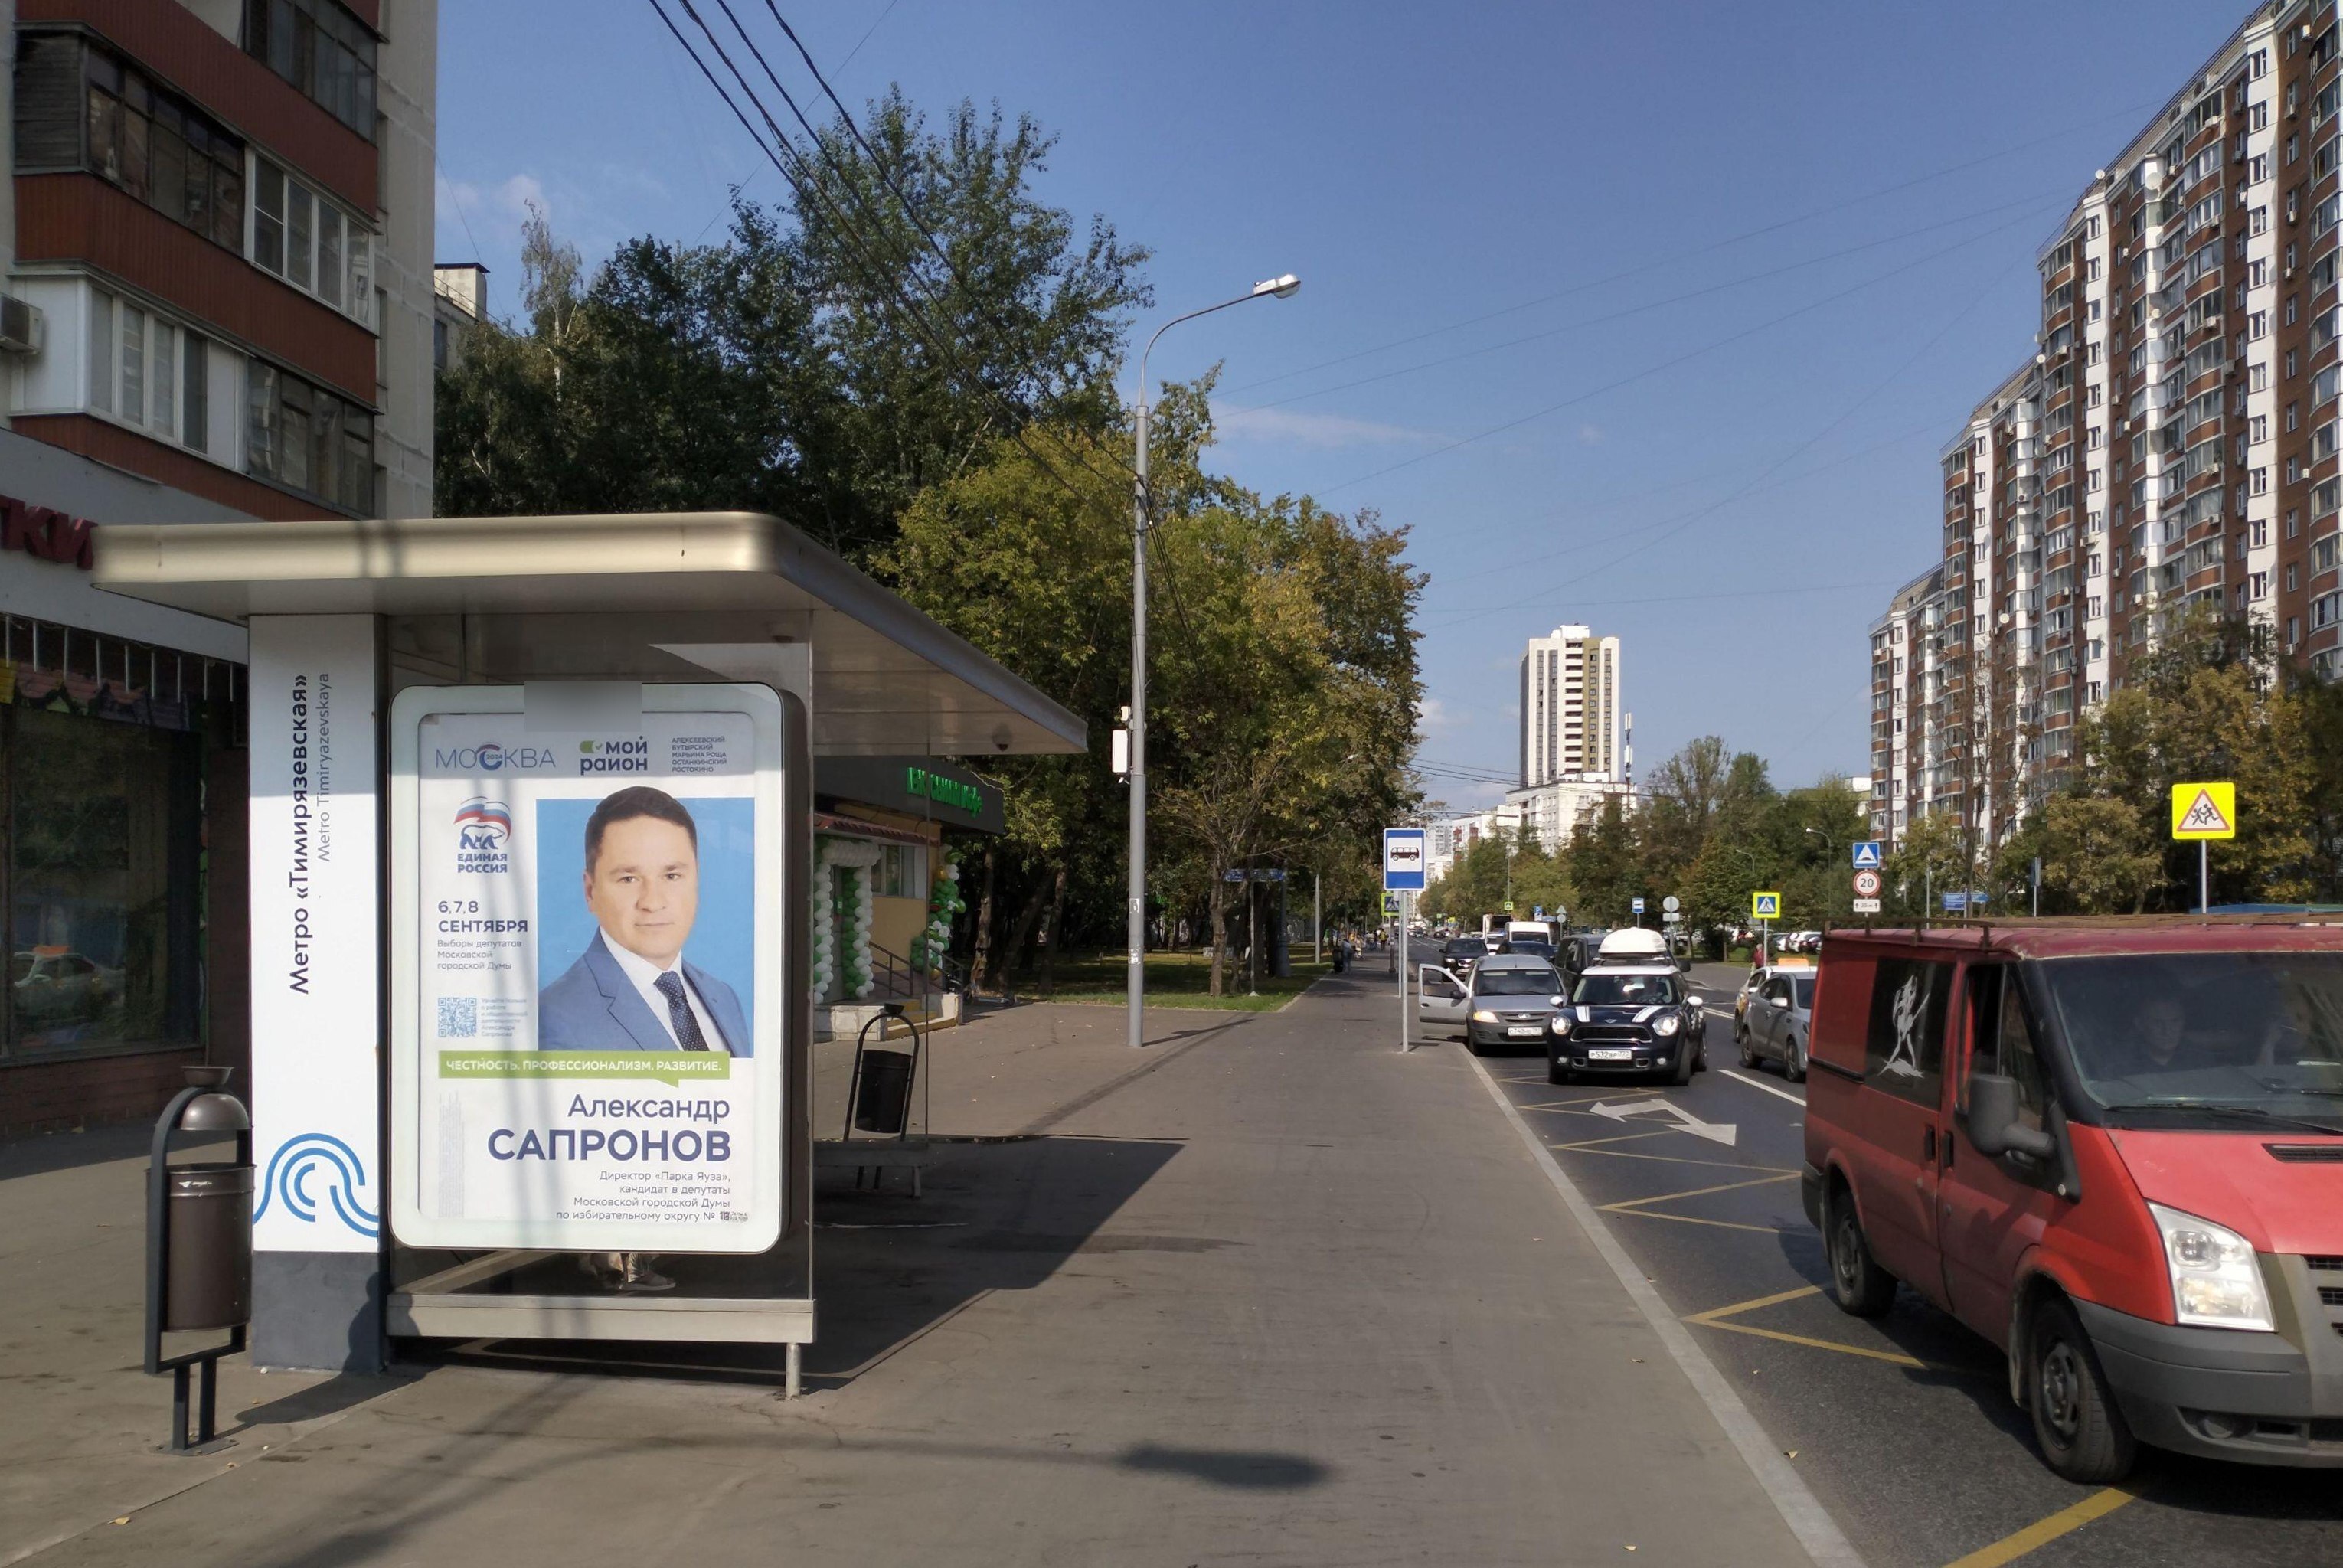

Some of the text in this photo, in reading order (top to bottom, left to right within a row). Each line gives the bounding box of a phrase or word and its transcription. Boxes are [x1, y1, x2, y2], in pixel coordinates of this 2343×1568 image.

[606, 735, 648, 754] мой
[672, 735, 726, 743] АЛЕКСЕЕВСКИЙ
[436, 743, 557, 771] МОСКВА
[316, 672, 332, 862] Metro Timiryazevskaya
[289, 674, 313, 994] Метро «Тимирязевская»
[458, 853, 508, 862] ЕДИНАЯ
[458, 864, 508, 873] РОССИЯ
[1860, 878, 1874, 888] 20
[438, 920, 528, 933] СЕНТЯБРЯ
[437, 939, 522, 949] Выборы депутатов
[437, 950, 493, 959] Московской
[487, 962, 512, 971] Думы
[446, 1060, 722, 1071] ЧЕСТНОСТЬ. ПРОФЕССИОНАЛИЗМ. РАЗВИТИЕ.
[567, 1093, 730, 1124] Александр
[487, 1128, 731, 1161] САПРОНОВ
[600, 1171, 730, 1183] Директор «Парка Яуза»,
[619, 1186, 668, 1194] кандидат
[681, 1187, 730, 1195] депутаты
[573, 1197, 730, 1209] Московской городской Думы
[573, 1210, 661, 1222] избирательному
[664, 1213, 700, 1223] округу
[704, 1211, 715, 1220] №
